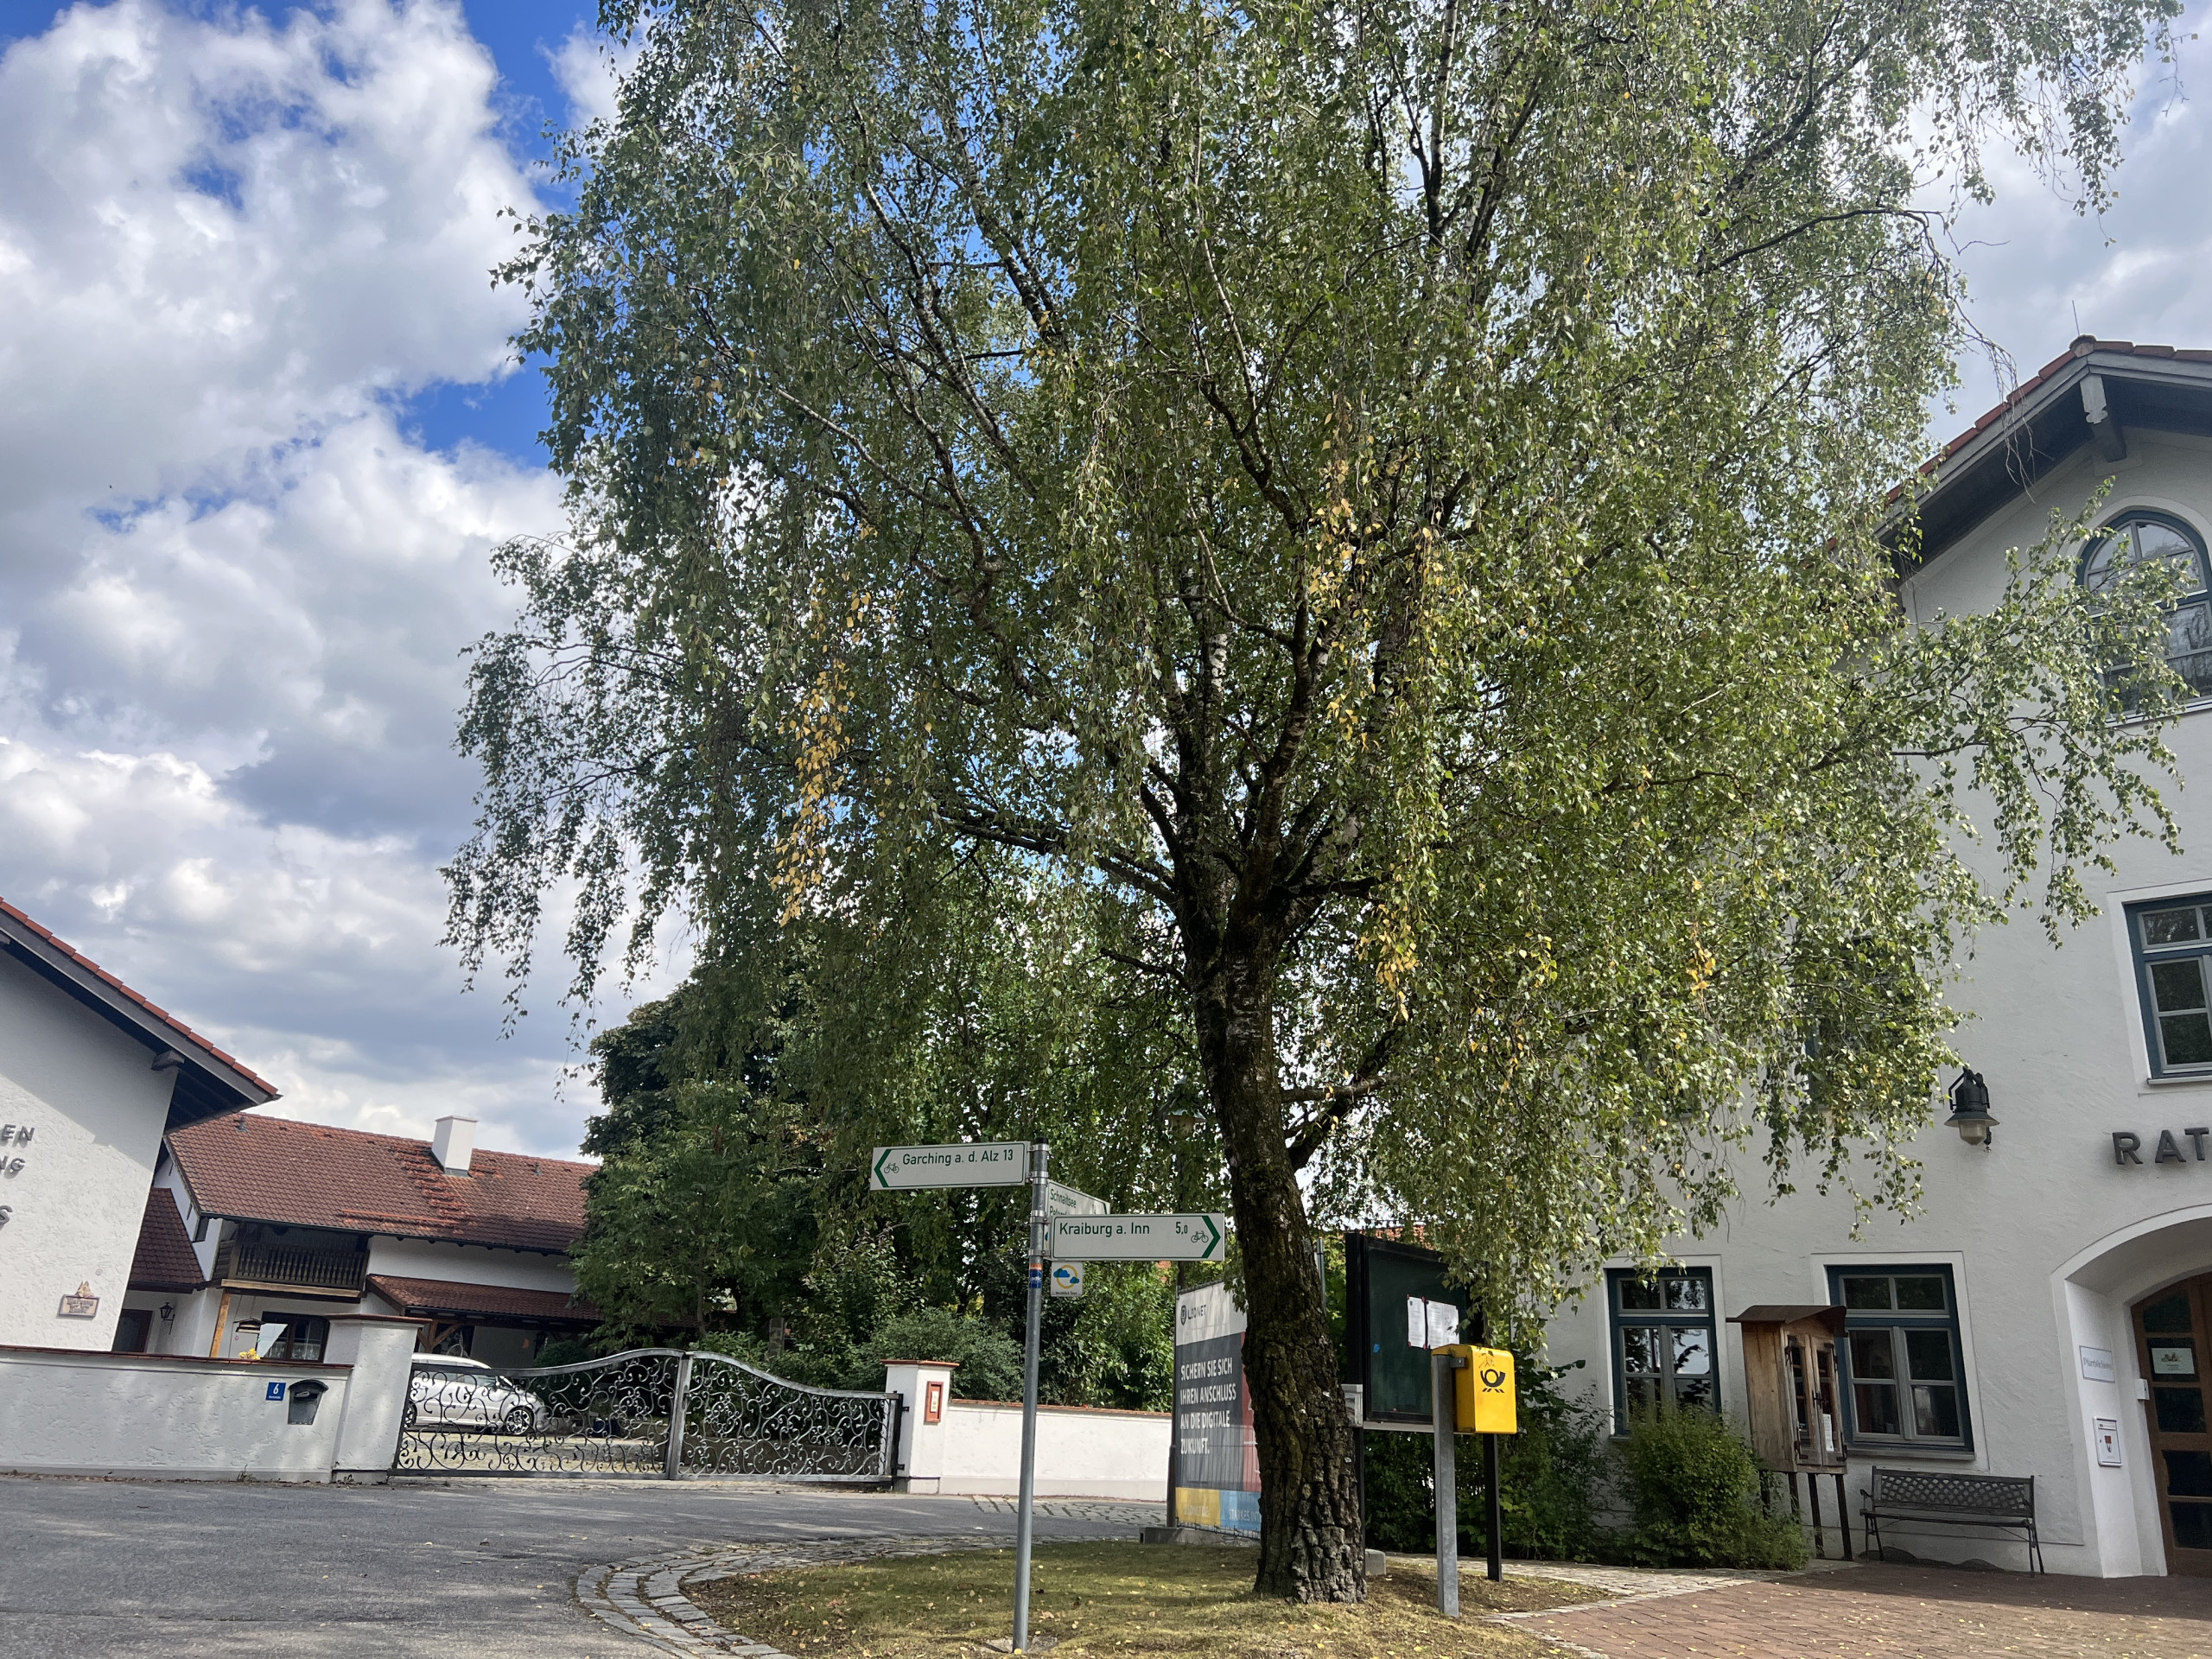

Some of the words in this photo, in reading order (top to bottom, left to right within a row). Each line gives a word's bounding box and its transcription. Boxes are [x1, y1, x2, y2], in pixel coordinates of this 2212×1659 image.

[3, 1124, 35, 1141] EN
[2113, 1127, 2209, 1165] RAT
[902, 1153, 951, 1166] Garching
[955, 1154, 964, 1163] a.
[968, 1151, 977, 1162] d.
[981, 1150, 999, 1162] Alz
[1003, 1149, 1014, 1161] 13
[1050, 1188, 1077, 1208] Schnaitsee
[1059, 1223, 1113, 1237] Kraiburg
[1116, 1224, 1127, 1235] a.
[1131, 1222, 1150, 1234] Inn
[1175, 1222, 1188, 1236] 5,0
[1180, 1361, 1206, 1381] SICHERN
[1207, 1359, 1217, 1378] SIE
[1217, 1357, 1232, 1376] SICH
[273, 1383, 279, 1394] 6
[1180, 1387, 1199, 1405] IHREN
[1199, 1383, 1236, 1403] ANSCHLUSS
[1180, 1413, 1190, 1430] AN
[1190, 1412, 1201, 1429] DIE
[1201, 1410, 1230, 1428] DIGITALE
[1180, 1438, 1210, 1455] ZUKUNFT.
